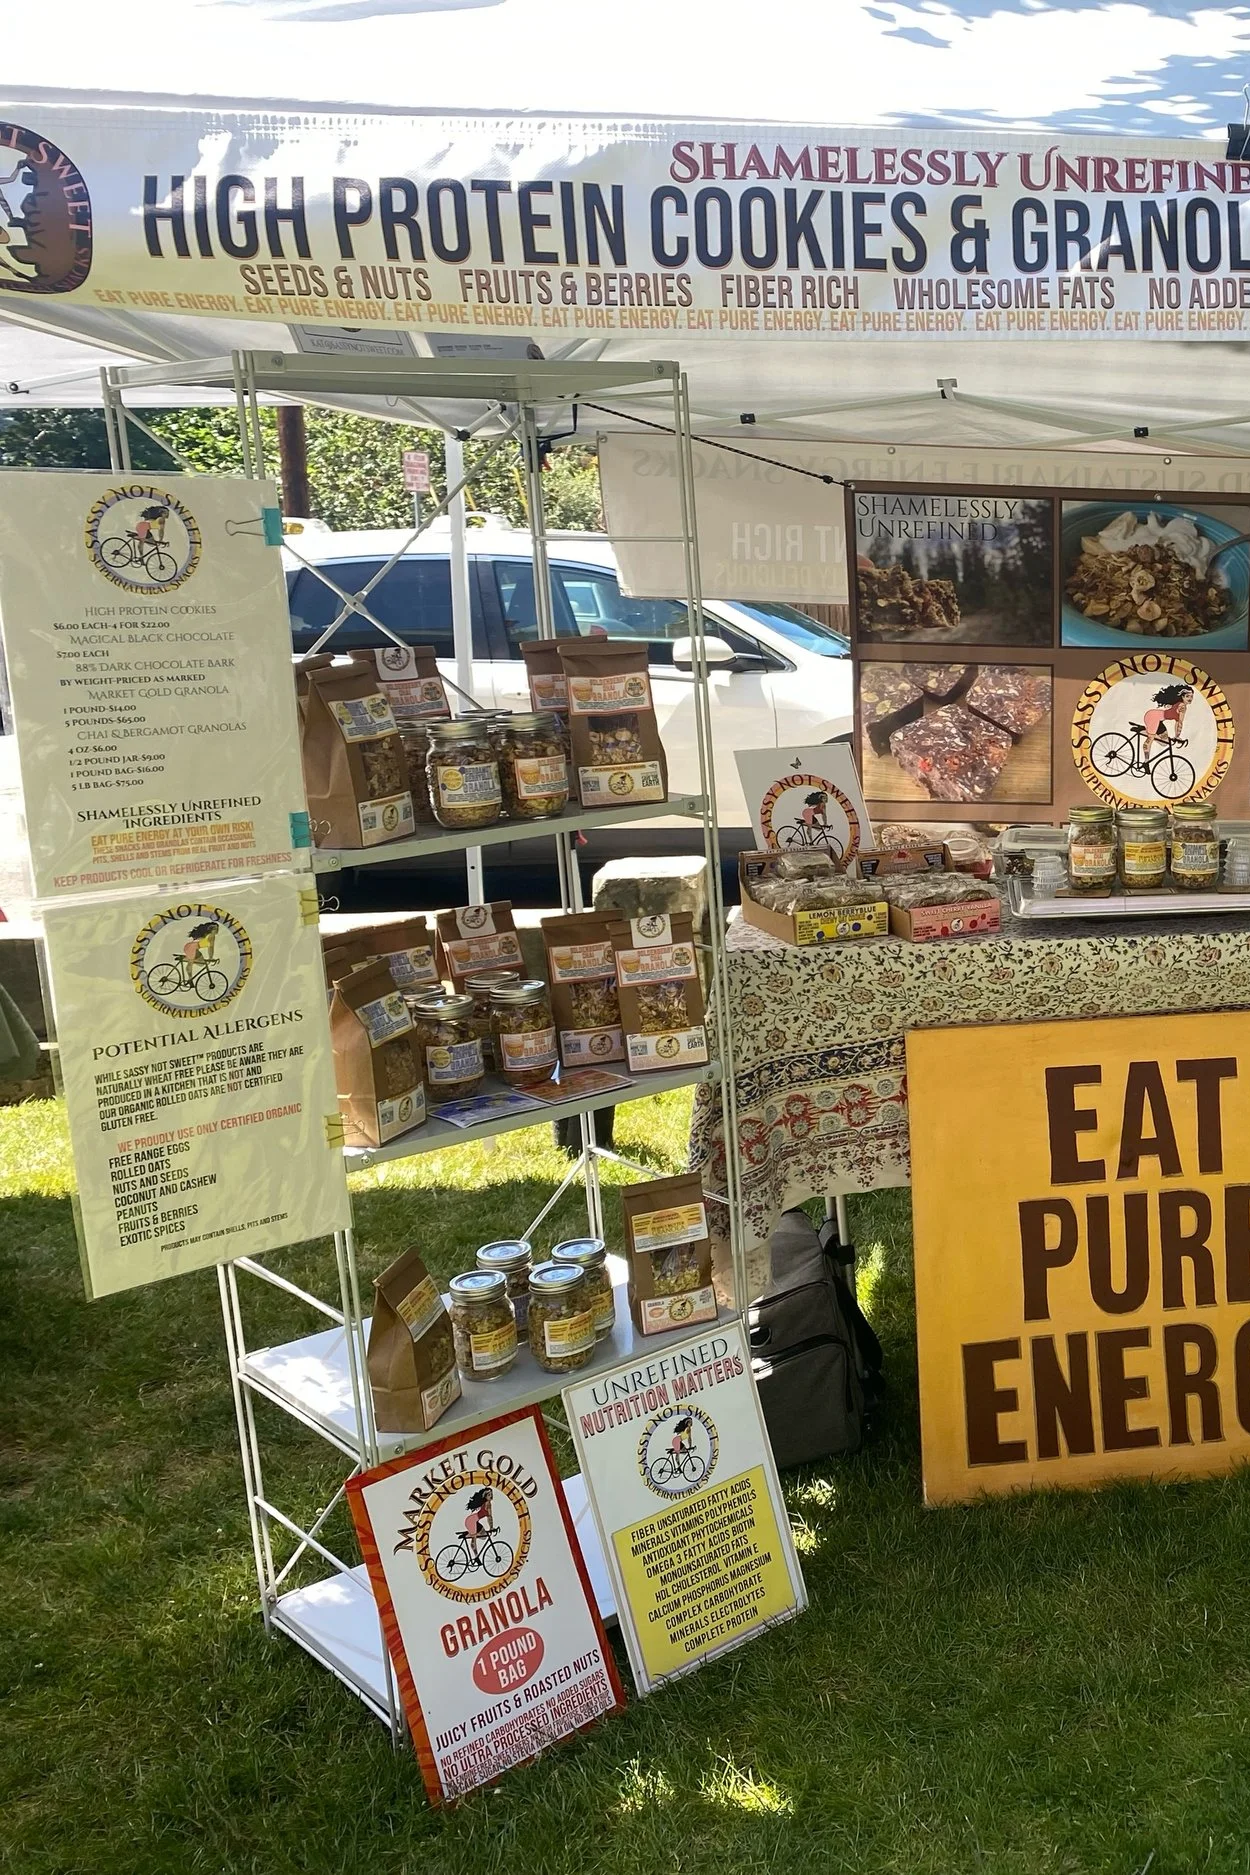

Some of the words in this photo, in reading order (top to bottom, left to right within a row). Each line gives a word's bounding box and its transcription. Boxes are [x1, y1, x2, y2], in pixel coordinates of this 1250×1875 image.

[671, 141, 1006, 188] SHAMELESSLY
[143, 175, 309, 262] HIGH
[333, 178, 626, 268] PROTEIN
[650, 185, 927, 274] COOKIES
[949, 194, 989, 274] &
[240, 265, 327, 298] SEEDS
[335, 267, 356, 299] &
[363, 267, 432, 301] NUTS
[459, 268, 553, 304] FRUITS
[560, 272, 578, 305] &
[585, 270, 692, 307] BERRIES
[721, 274, 794, 309] FIBER
[802, 275, 859, 309] RICH
[893, 276, 1052, 311] WHOLESOME
[1059, 276, 1115, 311] FATS
[1148, 277, 1182, 312] NO
[856, 495, 1018, 519] SHAMELESSLY
[858, 516, 998, 542] UNREFINED
[82, 622, 116, 630] EACH-4
[85, 607, 115, 617] HIGH
[119, 606, 167, 616] PROTEIN
[171, 606, 216, 614] COOKIES
[57, 651, 80, 659] $7.00
[83, 650, 109, 658] EACH
[70, 635, 125, 645] MAGICAL
[128, 634, 163, 643] BLACK
[166, 632, 235, 642] CHOCOLATE
[75, 677, 150, 685] WEIGHT-PRICED
[76, 663, 97, 672] 88%
[100, 662, 131, 672] DARK
[135, 659, 205, 670] CHOCOLATE
[208, 659, 234, 667] BARK
[88, 689, 135, 701] MARKET
[138, 688, 172, 699] GOLD
[175, 686, 228, 696] GRANOLA
[1072, 668, 1111, 750] SASSY
[1113, 654, 1181, 677] NOT
[1183, 666, 1234, 749] SWEET
[73, 716, 145, 726] POUNDS-$65.00
[77, 803, 179, 822] SHAMELESSLY
[182, 796, 261, 812] UNREFINED
[123, 811, 222, 829] INGREDIENTS
[809, 910, 835, 919] LEMON
[837, 906, 876, 916] BERRYBLUE
[93, 1030, 199, 1060] POTENTIAL
[203, 1010, 303, 1039] ALLERGENS
[1045, 1058, 1237, 1185] EAT
[109, 1157, 132, 1169] FREE
[135, 1147, 165, 1163] RANGE
[167, 1141, 190, 1155] EGGS
[111, 1165, 145, 1182] ROLLED
[148, 1158, 171, 1173] OATS
[115, 1189, 156, 1208] COCONUT
[159, 1183, 178, 1197] AND
[180, 1174, 217, 1191] CASHEW
[117, 1201, 158, 1221] PEANUTS
[119, 1216, 150, 1233] FRUITS
[153, 1214, 158, 1225] &
[161, 1204, 198, 1222] BERRIES
[120, 1230, 152, 1247] EXOTIC
[155, 1221, 185, 1238] SPICES
[592, 1339, 728, 1405] UNREFINED
[580, 1384, 669, 1438] NUTRITION
[672, 1355, 743, 1401] MATTERS
[394, 1451, 468, 1555] MARKET
[477, 1450, 538, 1499] GOLD
[631, 1523, 655, 1542] FIBER
[657, 1500, 707, 1529] UNSATURATED
[708, 1488, 728, 1507] FATTY
[730, 1478, 751, 1495] ACIDS
[647, 1557, 675, 1578] OMEGA
[678, 1554, 682, 1564] 3
[684, 1541, 706, 1561] FATTY
[708, 1531, 730, 1550] ACIDS
[732, 1517, 755, 1536] BIOTIN
[440, 1577, 553, 1658] GRANOLA
[685, 1623, 725, 1652] COMPLETE
[727, 1606, 758, 1630] PROTEIN
[478, 1658, 487, 1675] 1
[490, 1632, 536, 1671] POUND
[498, 1660, 526, 1688] BAG
[436, 1722, 468, 1752] JUICY
[471, 1701, 511, 1732] FRUITS
[515, 1694, 522, 1707] &
[524, 1665, 571, 1702] ROASTED
[573, 1650, 600, 1674] NUTS
